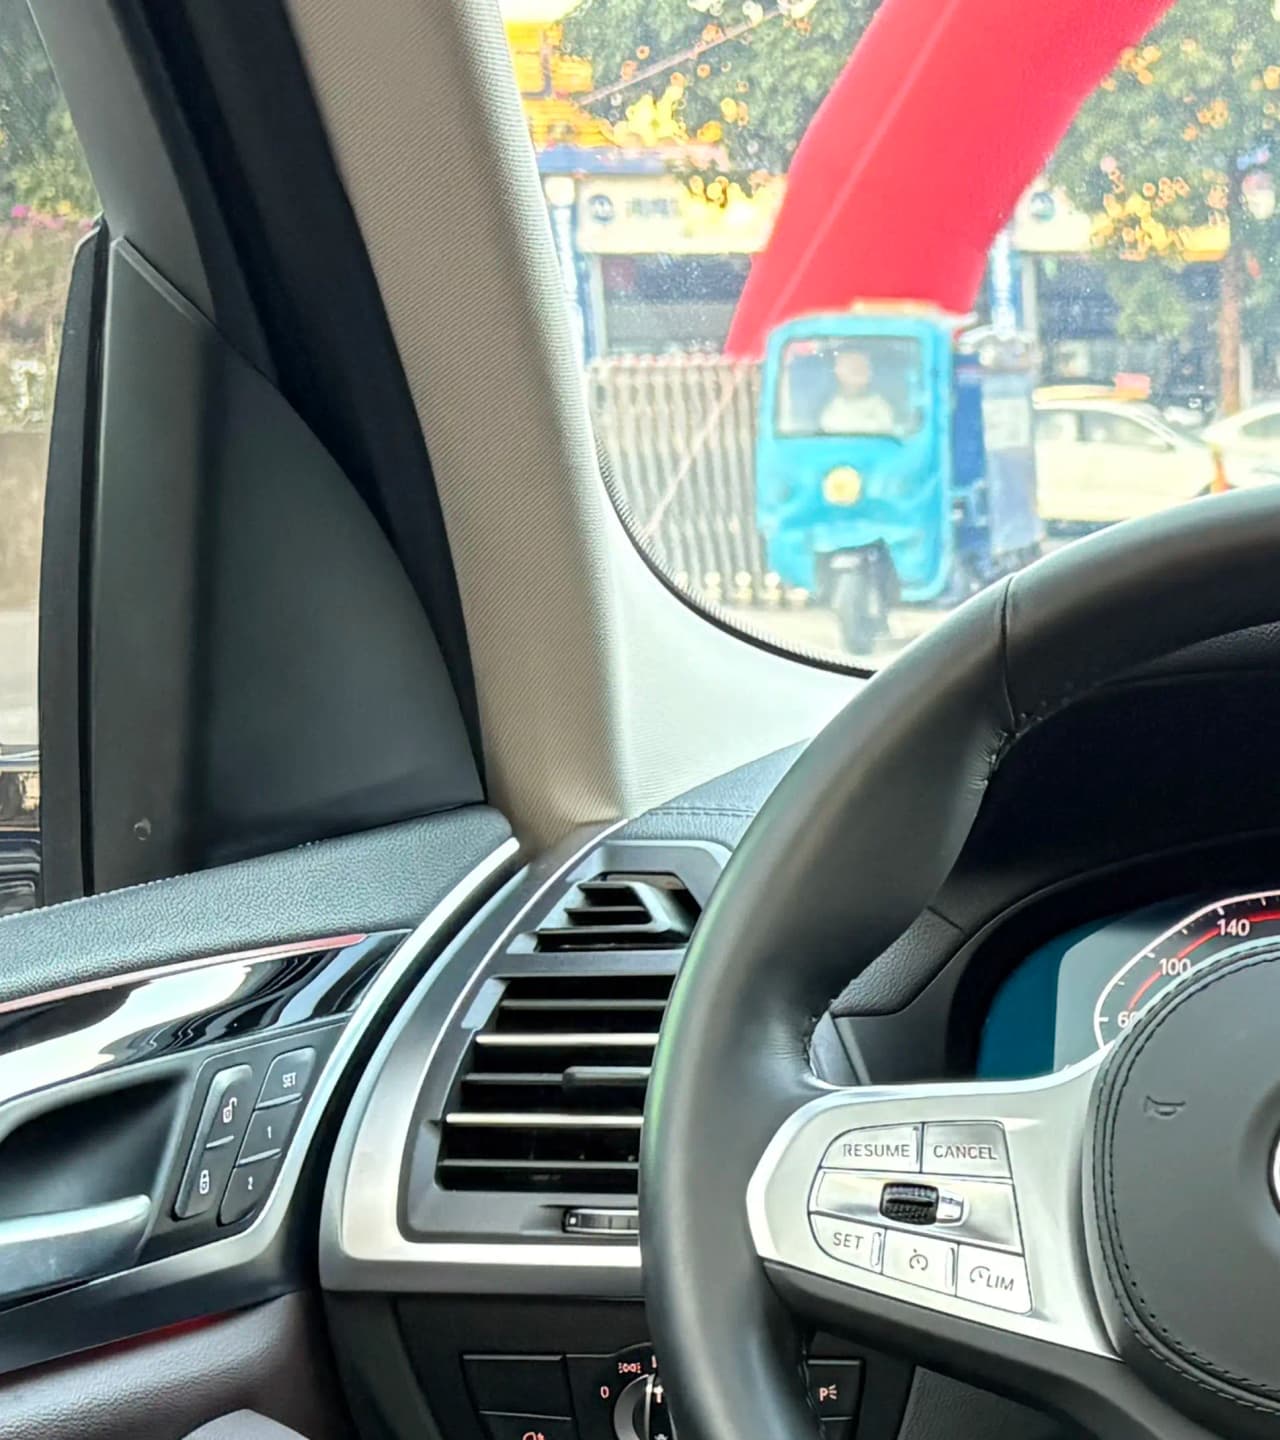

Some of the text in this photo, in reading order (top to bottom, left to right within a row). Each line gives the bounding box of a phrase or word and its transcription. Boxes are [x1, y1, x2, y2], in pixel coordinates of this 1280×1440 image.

[1217, 918, 1250, 937] 140
[1159, 957, 1192, 976] 100
[282, 1072, 297, 1088] SET
[843, 1143, 911, 1158] RESUME
[933, 1144, 998, 1161] CANCEL
[832, 1232, 865, 1250] SET
[986, 1273, 1016, 1293] LIM
